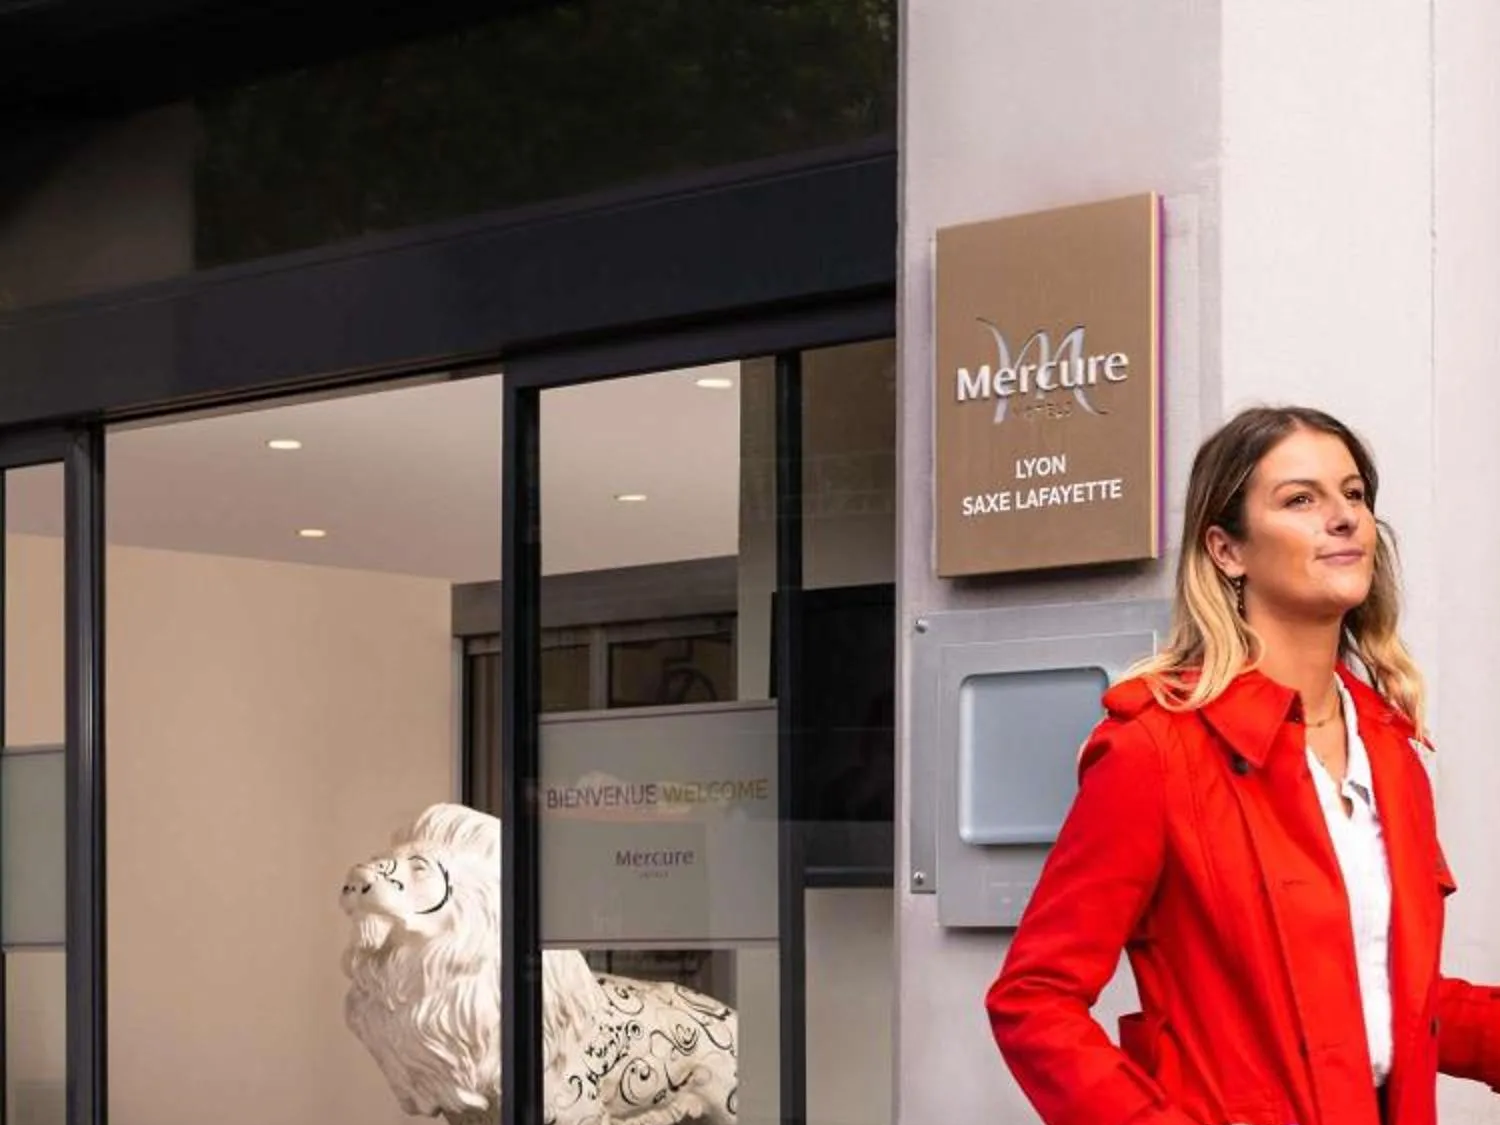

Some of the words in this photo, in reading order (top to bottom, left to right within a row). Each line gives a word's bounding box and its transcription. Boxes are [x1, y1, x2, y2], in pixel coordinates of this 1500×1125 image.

[956, 351, 1129, 402] Mercure
[1015, 454, 1066, 479] LYON
[962, 492, 1011, 517] SAXE
[1016, 479, 1123, 510] LAFAYETTE
[546, 784, 657, 809] BIENVENUE
[664, 778, 769, 803] WELCOME
[615, 850, 694, 867] Mercure
